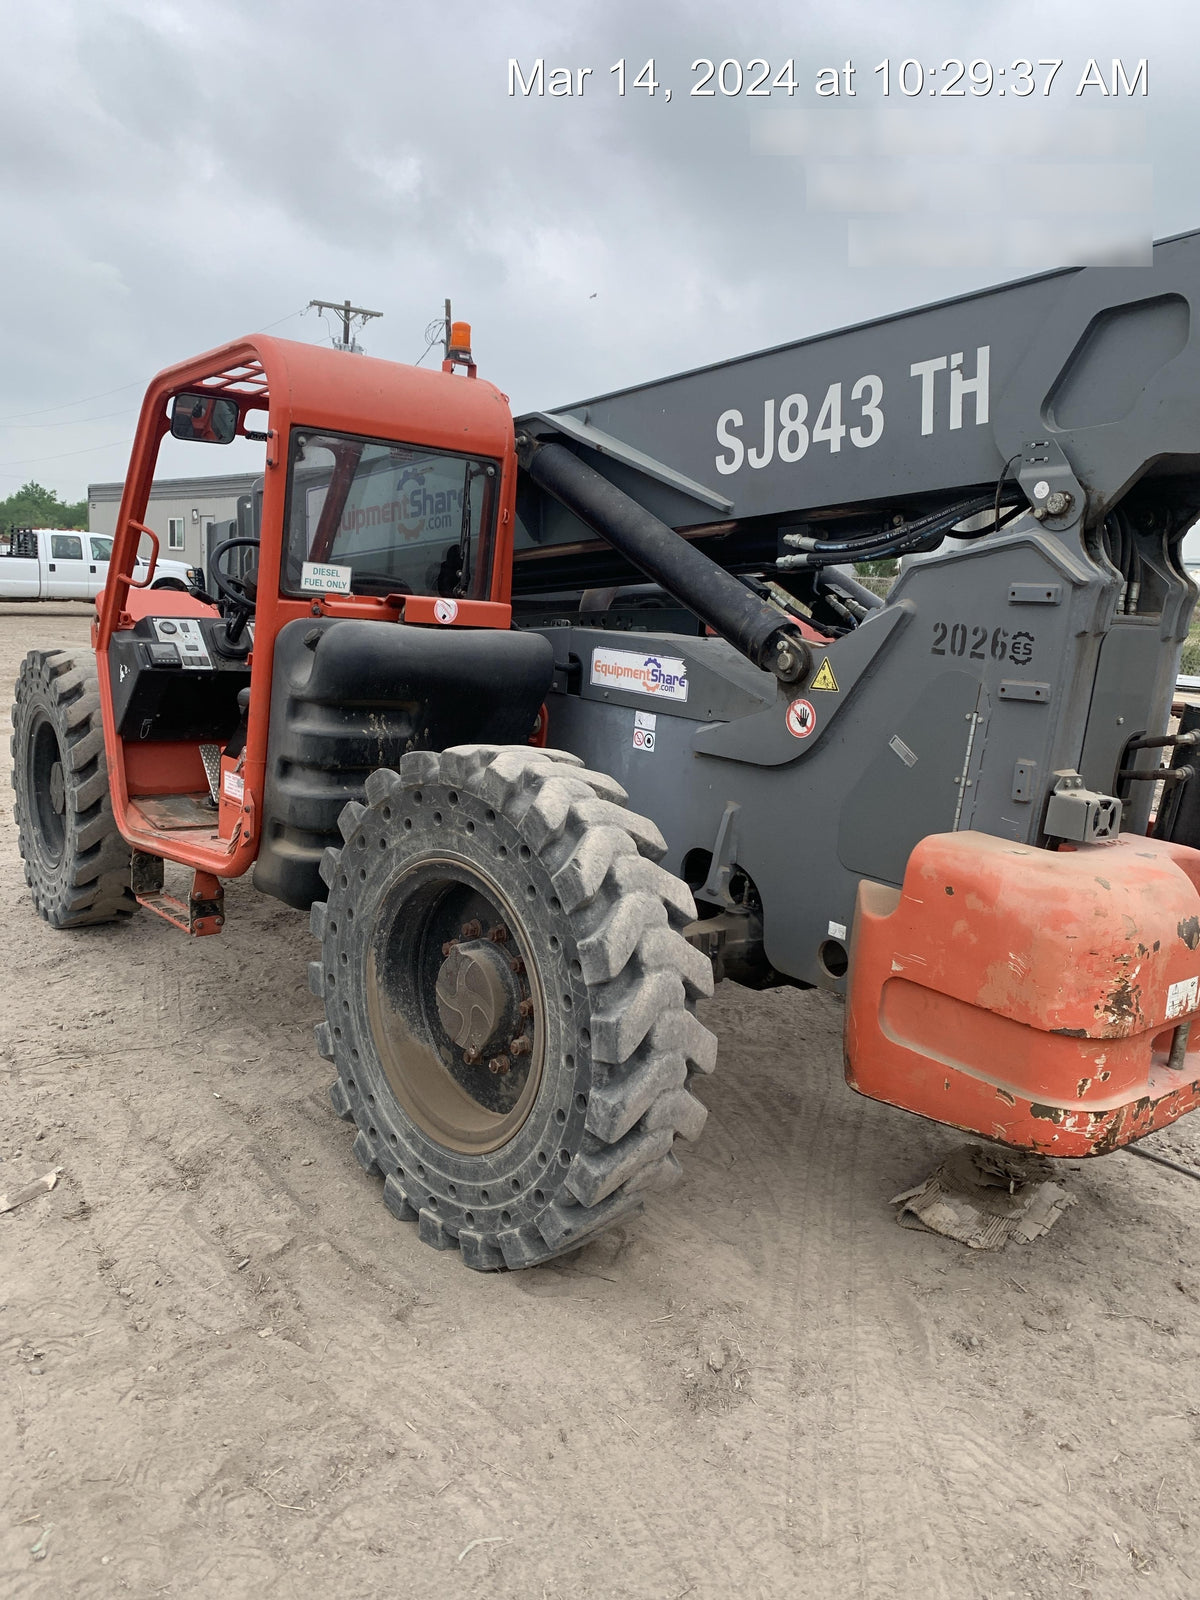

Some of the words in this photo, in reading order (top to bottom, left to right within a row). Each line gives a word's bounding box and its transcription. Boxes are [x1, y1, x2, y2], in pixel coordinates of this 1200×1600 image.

[715, 374, 885, 475] SJ843
[910, 345, 990, 436] TH
[336, 487, 465, 538] uipmentShar
[304, 577, 324, 587] FUEL
[326, 579, 347, 589] ONLY
[312, 567, 341, 578] DIESEL
[930, 622, 1008, 661] 2026
[594, 659, 686, 687] EquipmentShare
[658, 684, 675, 693] .com
